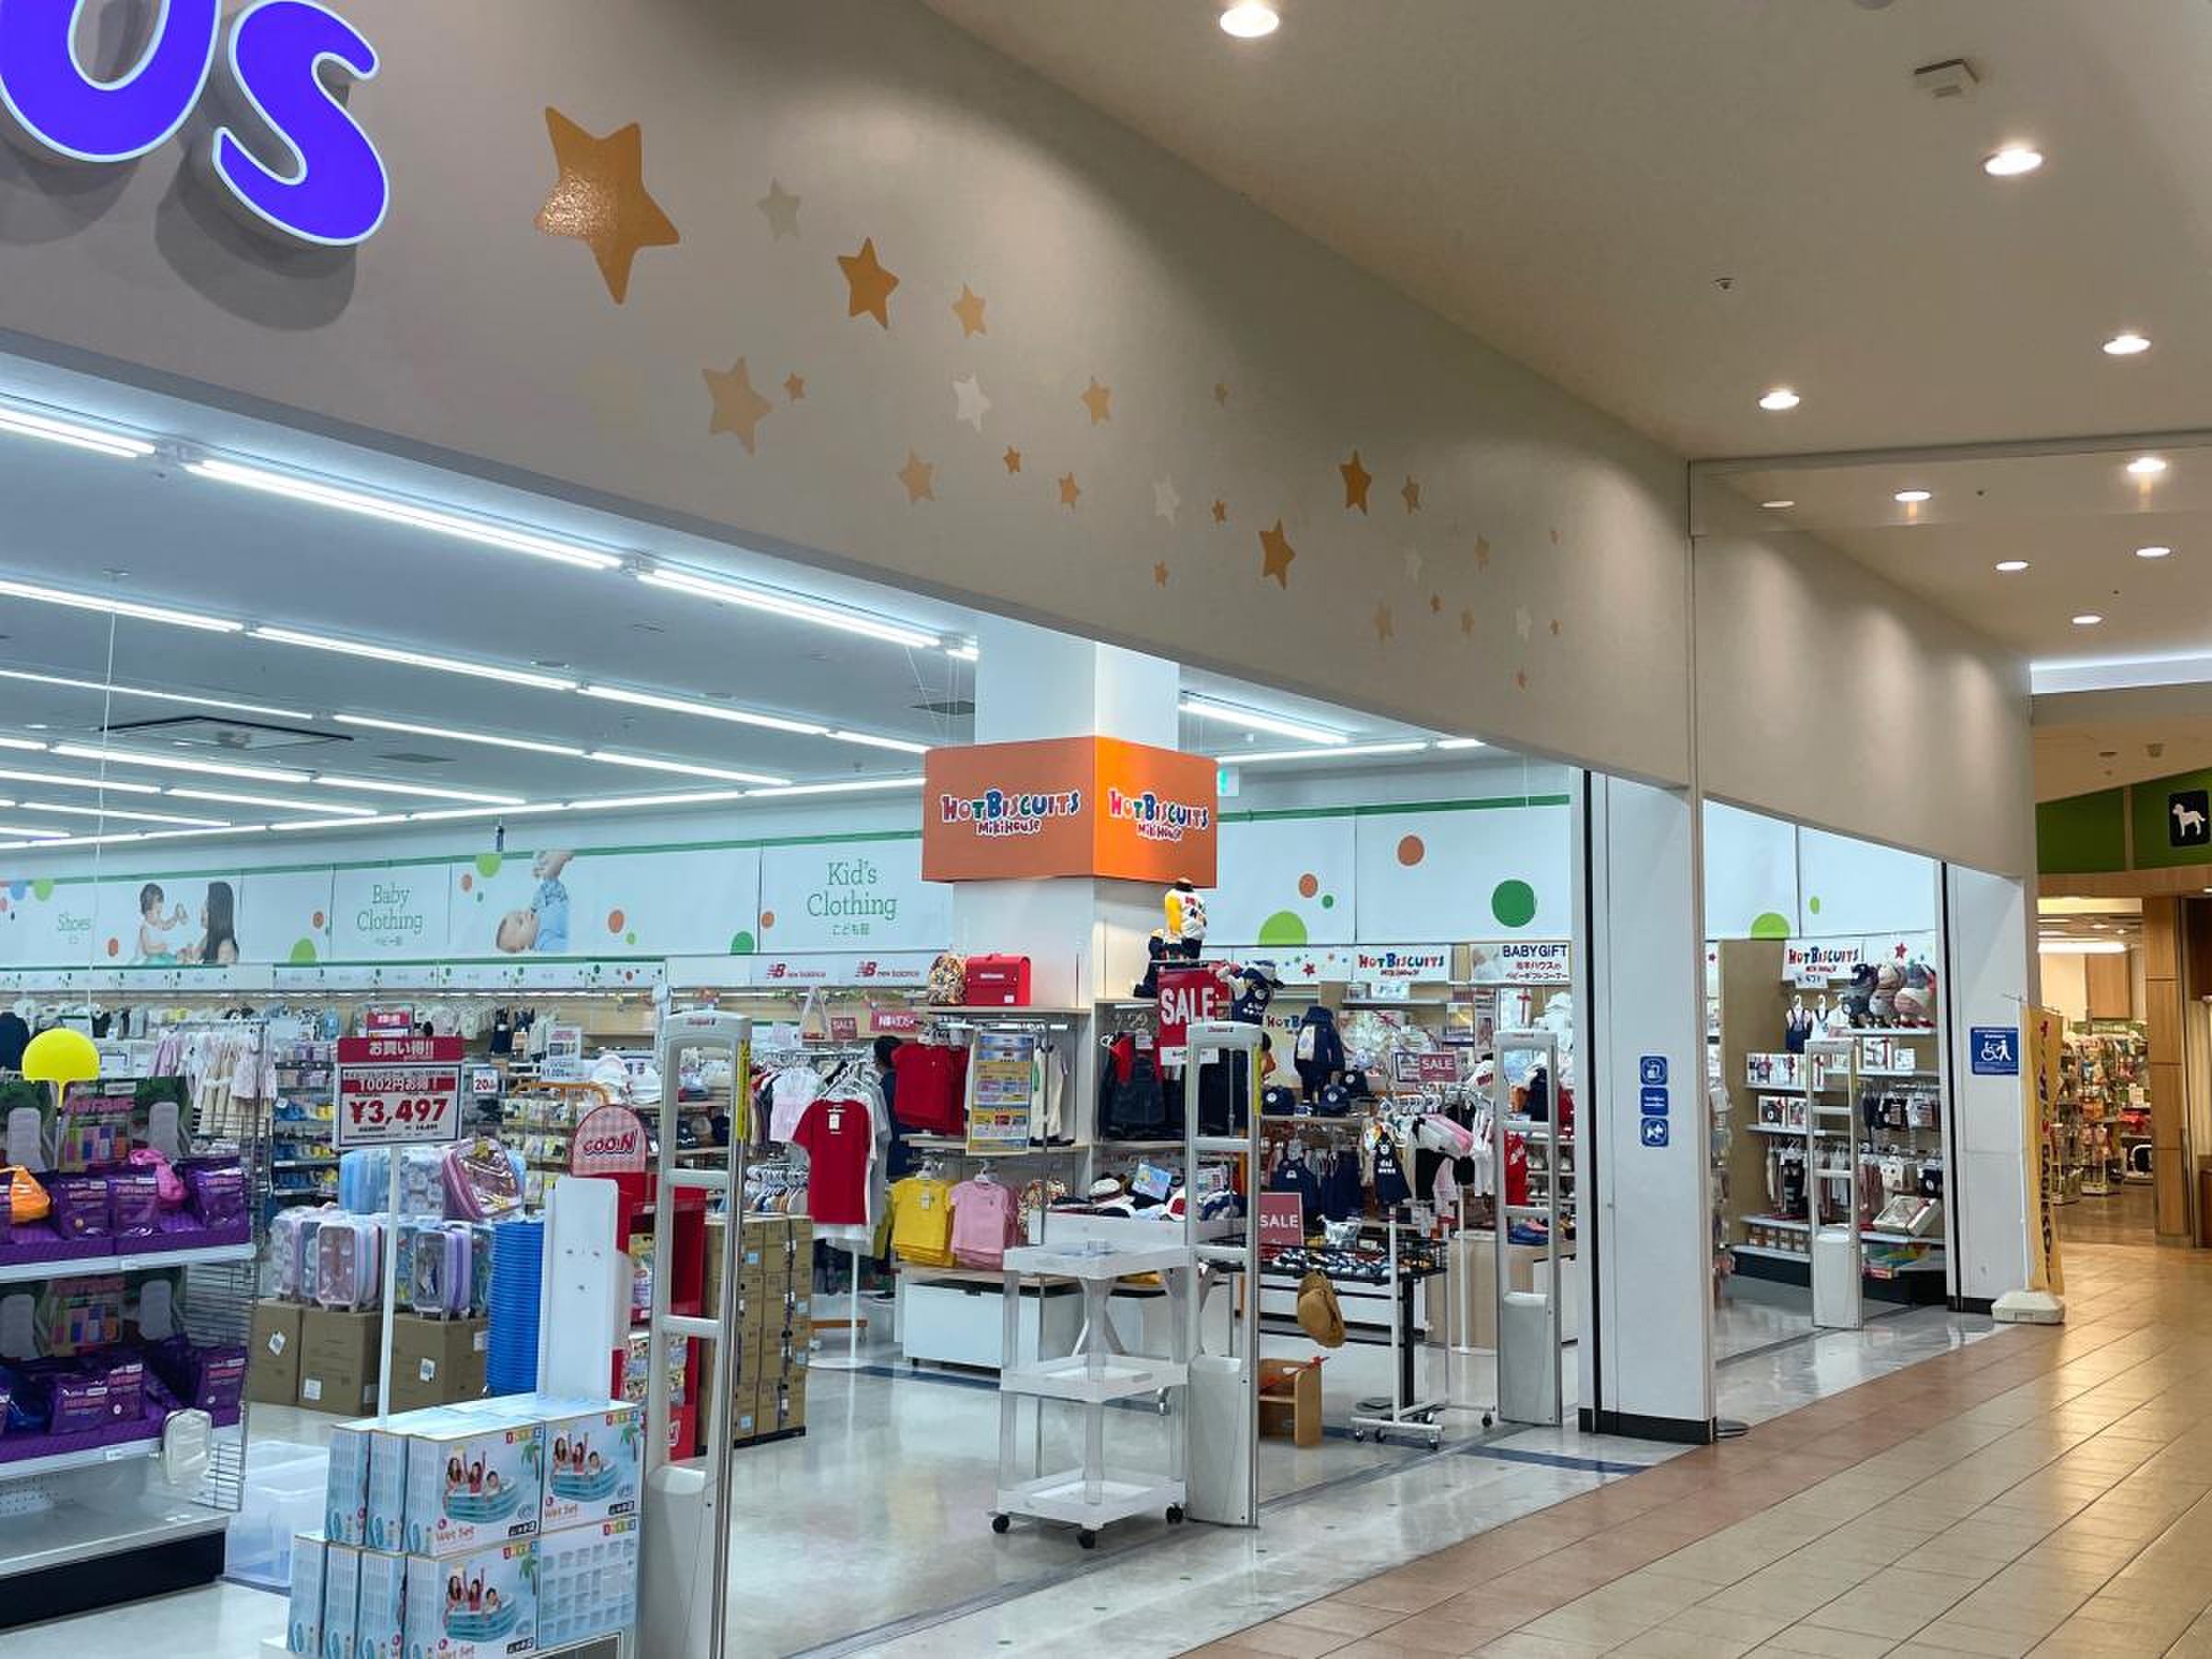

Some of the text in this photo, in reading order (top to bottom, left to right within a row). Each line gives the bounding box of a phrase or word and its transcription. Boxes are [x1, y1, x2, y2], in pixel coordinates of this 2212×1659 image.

[827, 857, 877, 886] Kid's
[372, 881, 411, 910] Baby
[806, 888, 898, 921] Clothing
[356, 909, 423, 935] Clothing
[1160, 987, 1215, 1026] SALE
[1421, 1059, 1454, 1070] SALE
[349, 1098, 449, 1125] ¥3,497
[1259, 1214, 1300, 1229] SALE
